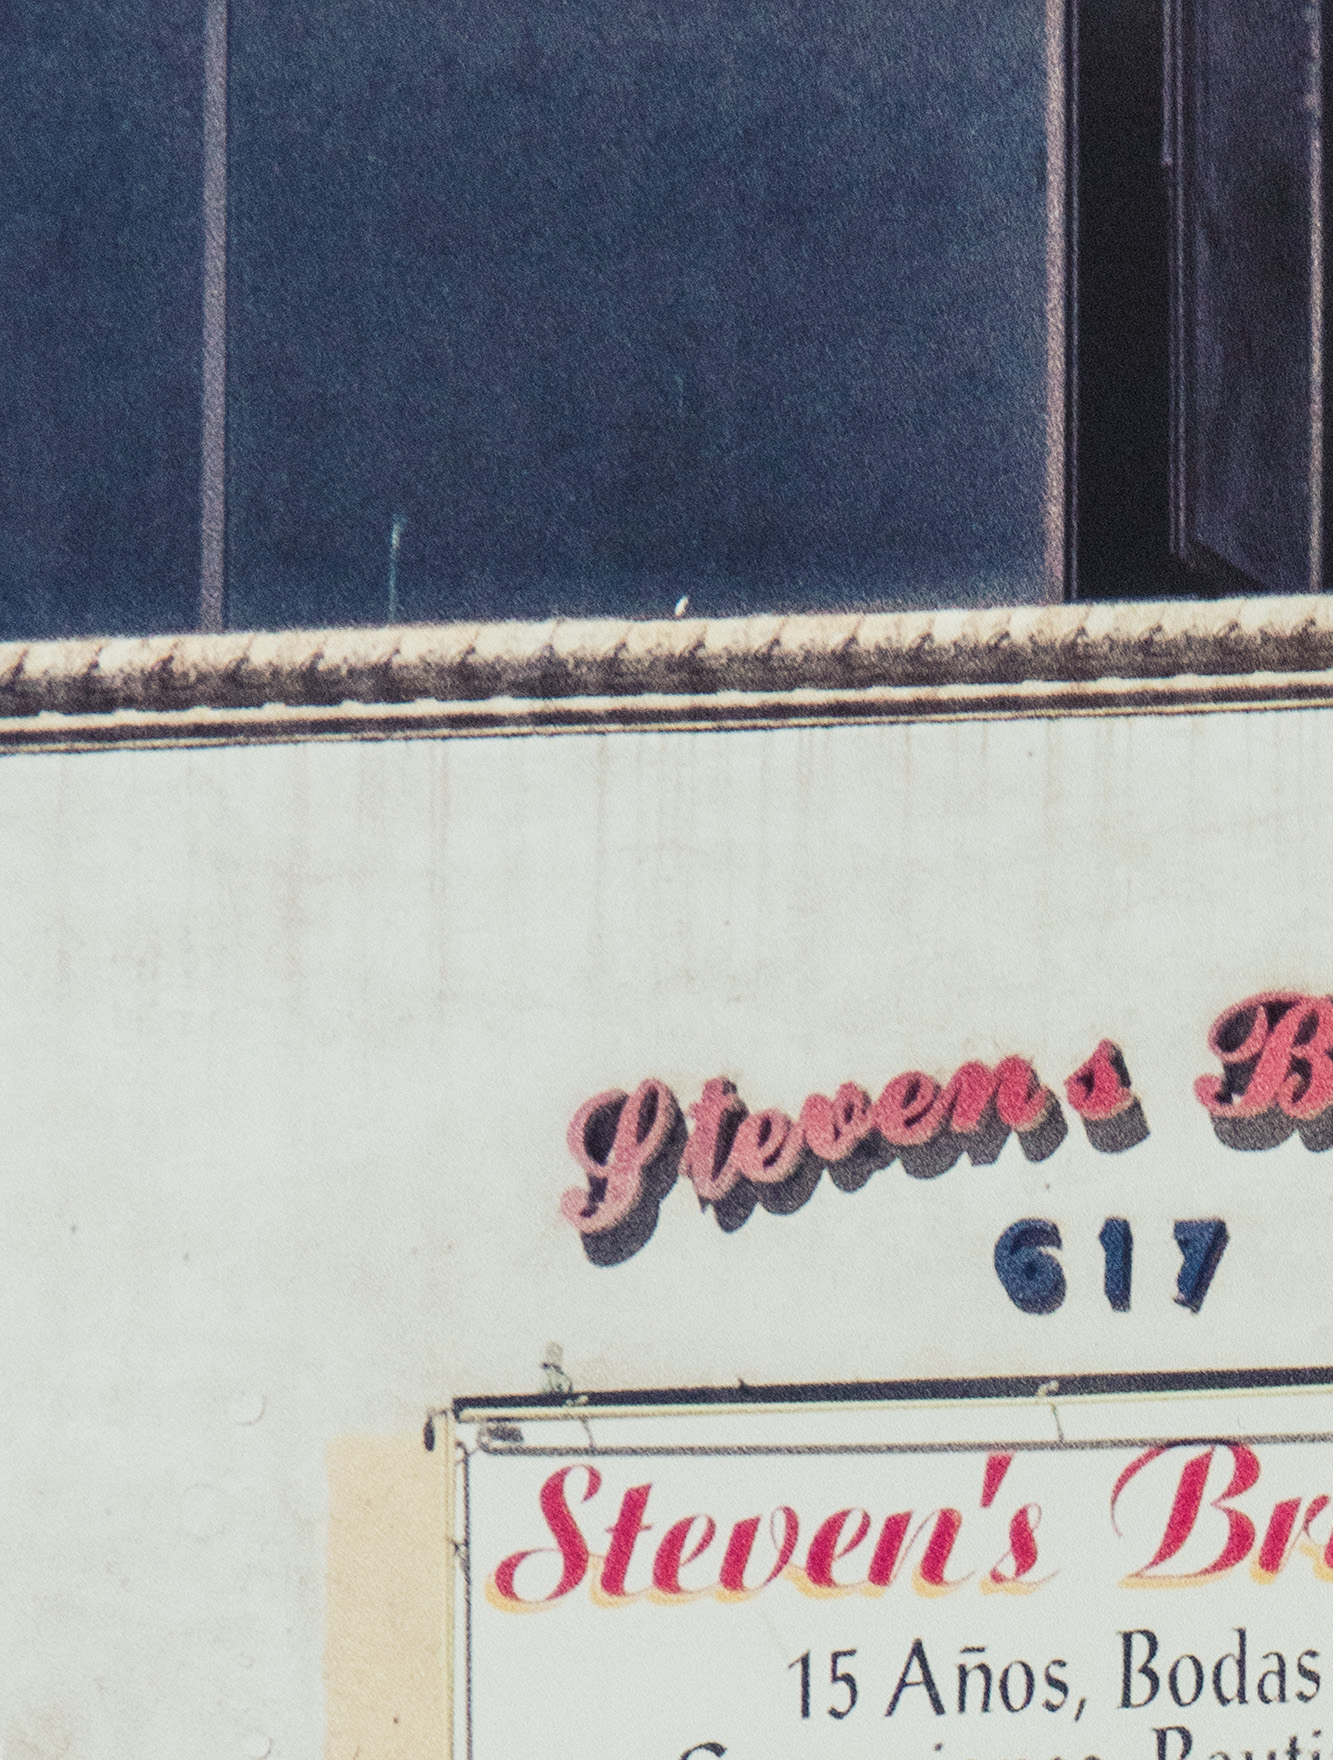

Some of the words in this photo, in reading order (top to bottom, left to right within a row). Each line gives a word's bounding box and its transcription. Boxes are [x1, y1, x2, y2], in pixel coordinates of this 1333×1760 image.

[559, 1038, 1136, 1236] Stevens
[992, 1217, 1230, 1316] 617
[486, 1450, 1062, 1606] Steven's
[786, 1650, 860, 1720] 15
[884, 1638, 1089, 1724] Años,
[1114, 1628, 1324, 1711] Bodas
